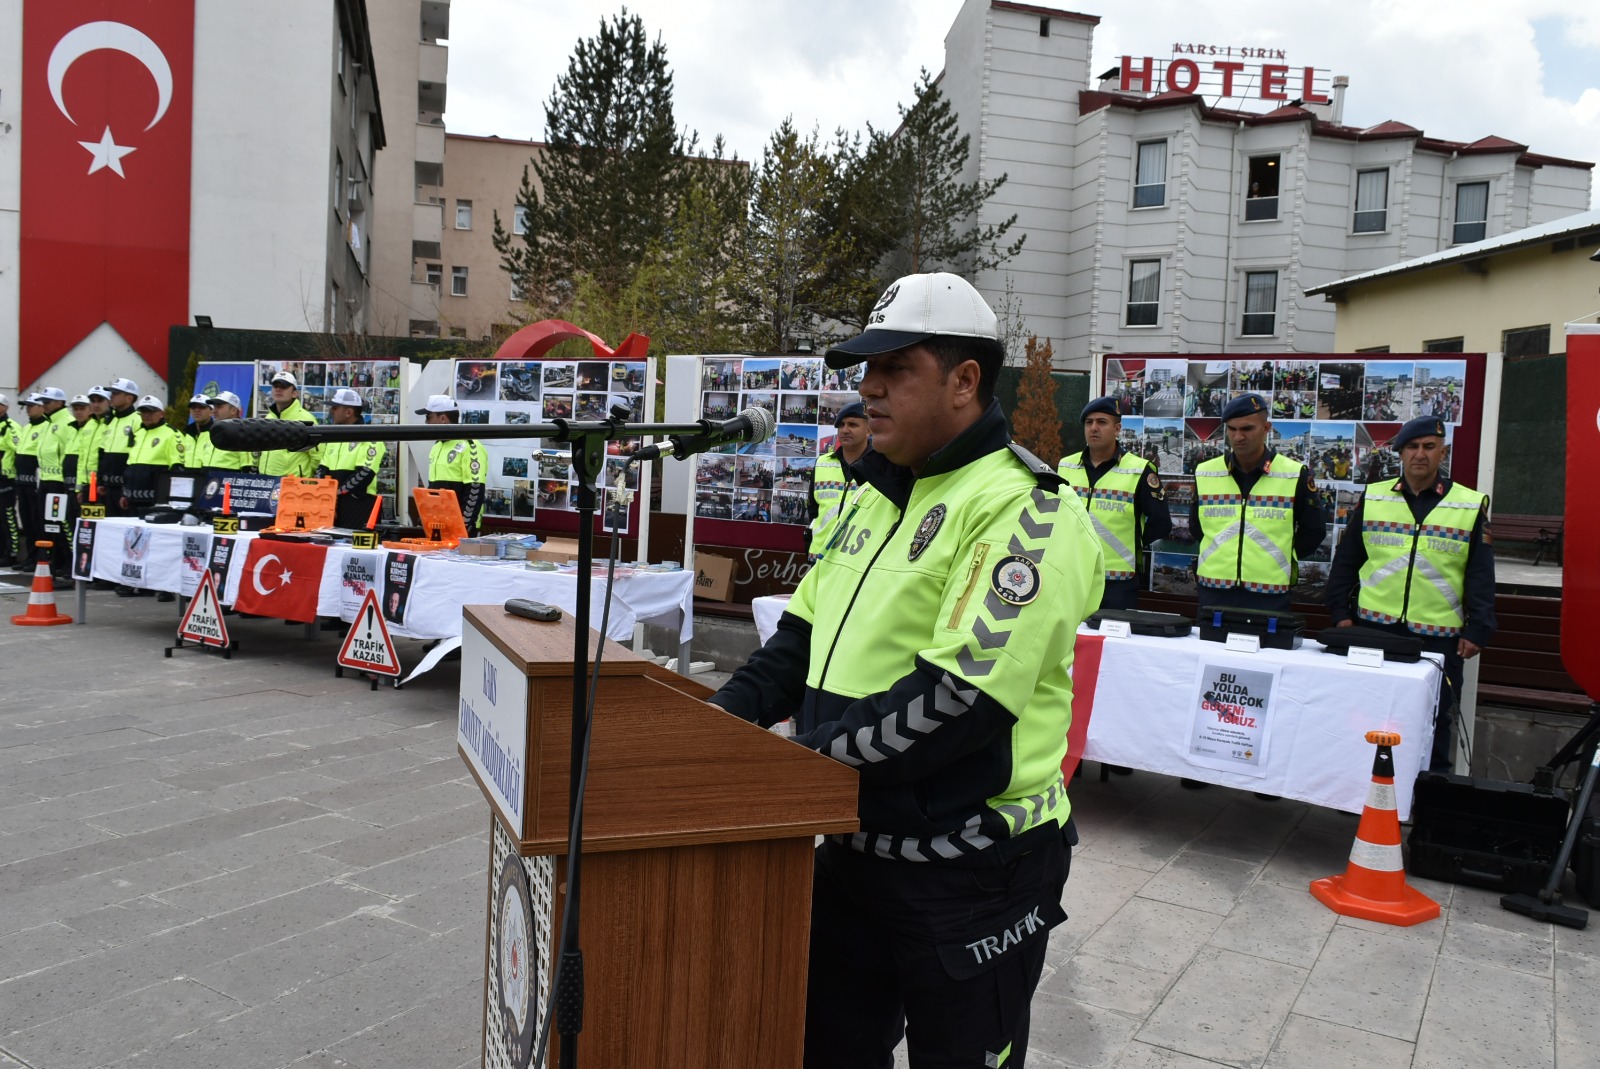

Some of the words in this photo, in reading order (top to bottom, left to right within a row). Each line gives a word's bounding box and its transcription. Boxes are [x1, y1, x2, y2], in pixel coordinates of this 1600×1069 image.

[1119, 55, 1329, 104] HOTEL
[350, 557, 359, 565] BU
[1015, 556, 1035, 570] KARS
[346, 564, 366, 574] YOLDA
[695, 576, 714, 588] FAIRY
[192, 614, 217, 627] TRAFİK
[187, 623, 220, 638] KONTROL
[353, 638, 385, 653] TRAFİK
[353, 650, 385, 664] KAZASI
[483, 656, 498, 707] KARS
[1219, 673, 1236, 684] BU
[1212, 682, 1248, 696] YOLDA
[459, 697, 482, 757] EMNİYET
[481, 718, 521, 818] MÜDÜRLÜĞÜ
